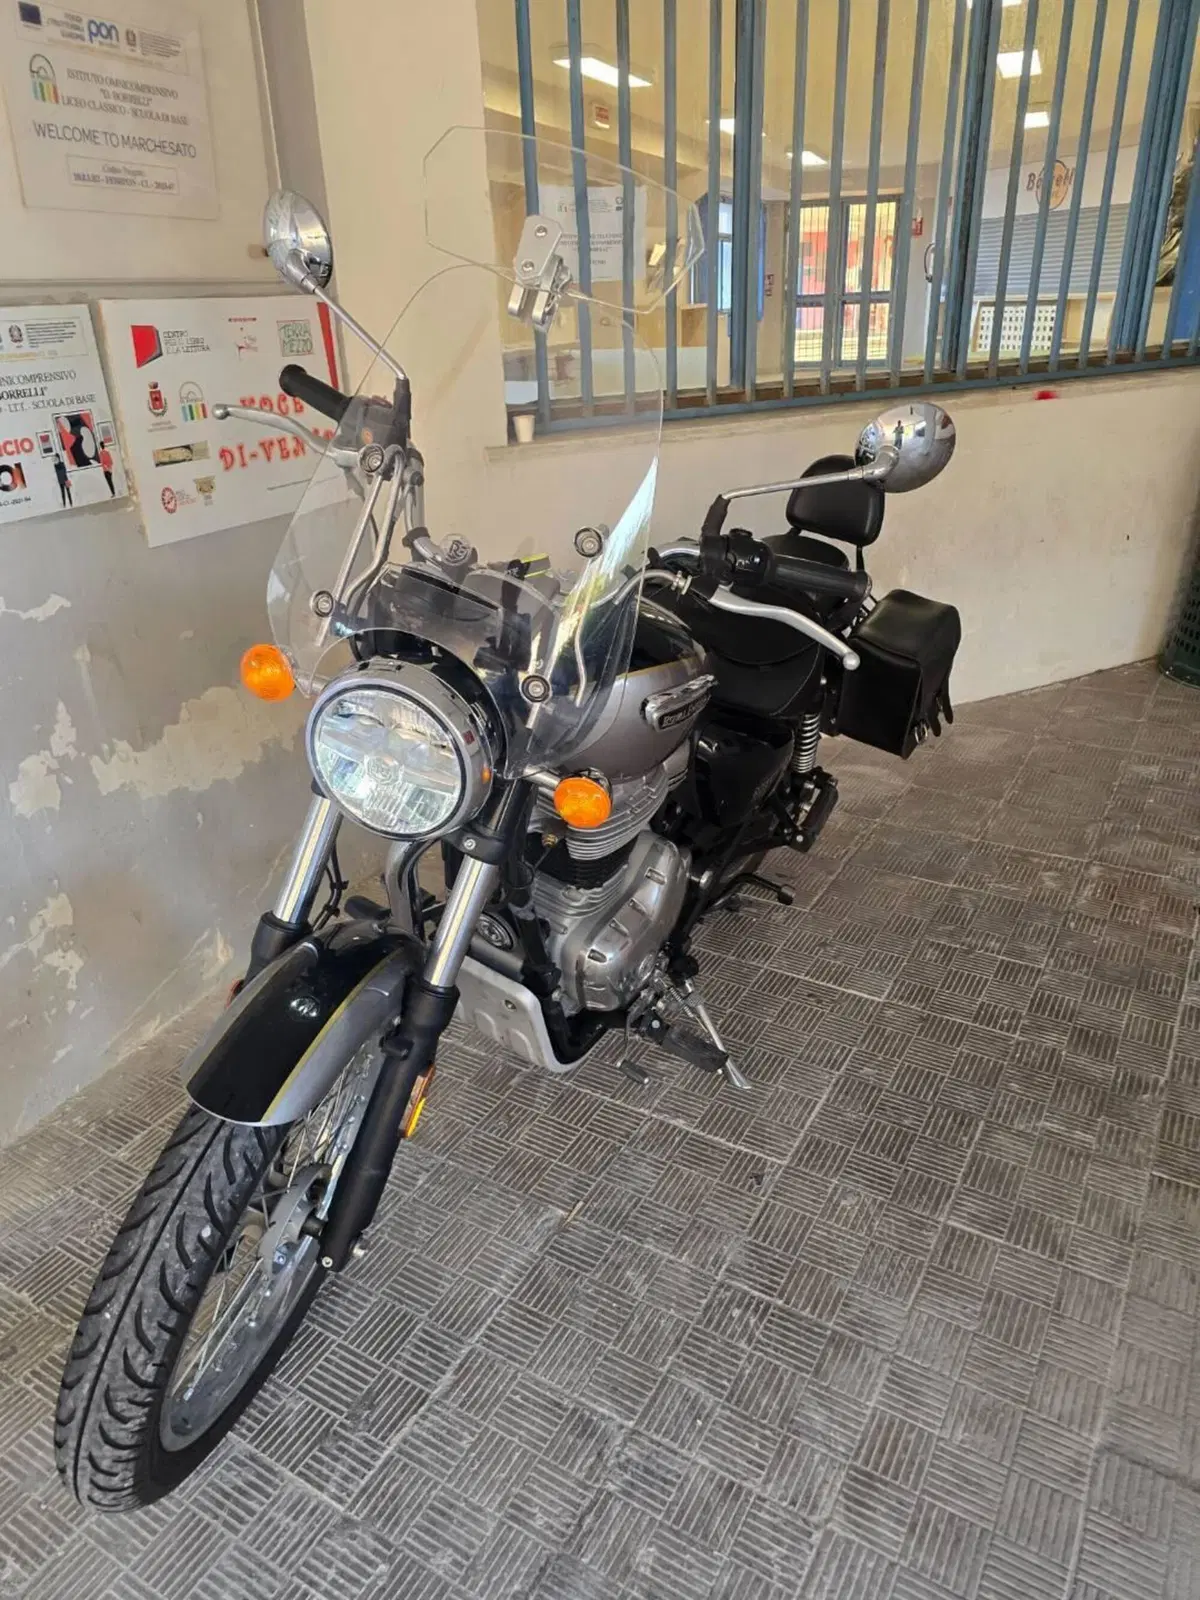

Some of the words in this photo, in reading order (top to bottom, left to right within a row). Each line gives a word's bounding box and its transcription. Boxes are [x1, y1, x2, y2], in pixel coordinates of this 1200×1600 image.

[88, 19, 119, 44] pon
[33, 121, 100, 146] WELCOME
[102, 131, 119, 149] TO
[121, 134, 197, 159] MARCHESATO
[0, 386, 48, 400] ORRELLI"
[31, 398, 65, 409] SCUOLA
[75, 394, 96, 404] BASE
[0, 437, 34, 457] CIO
